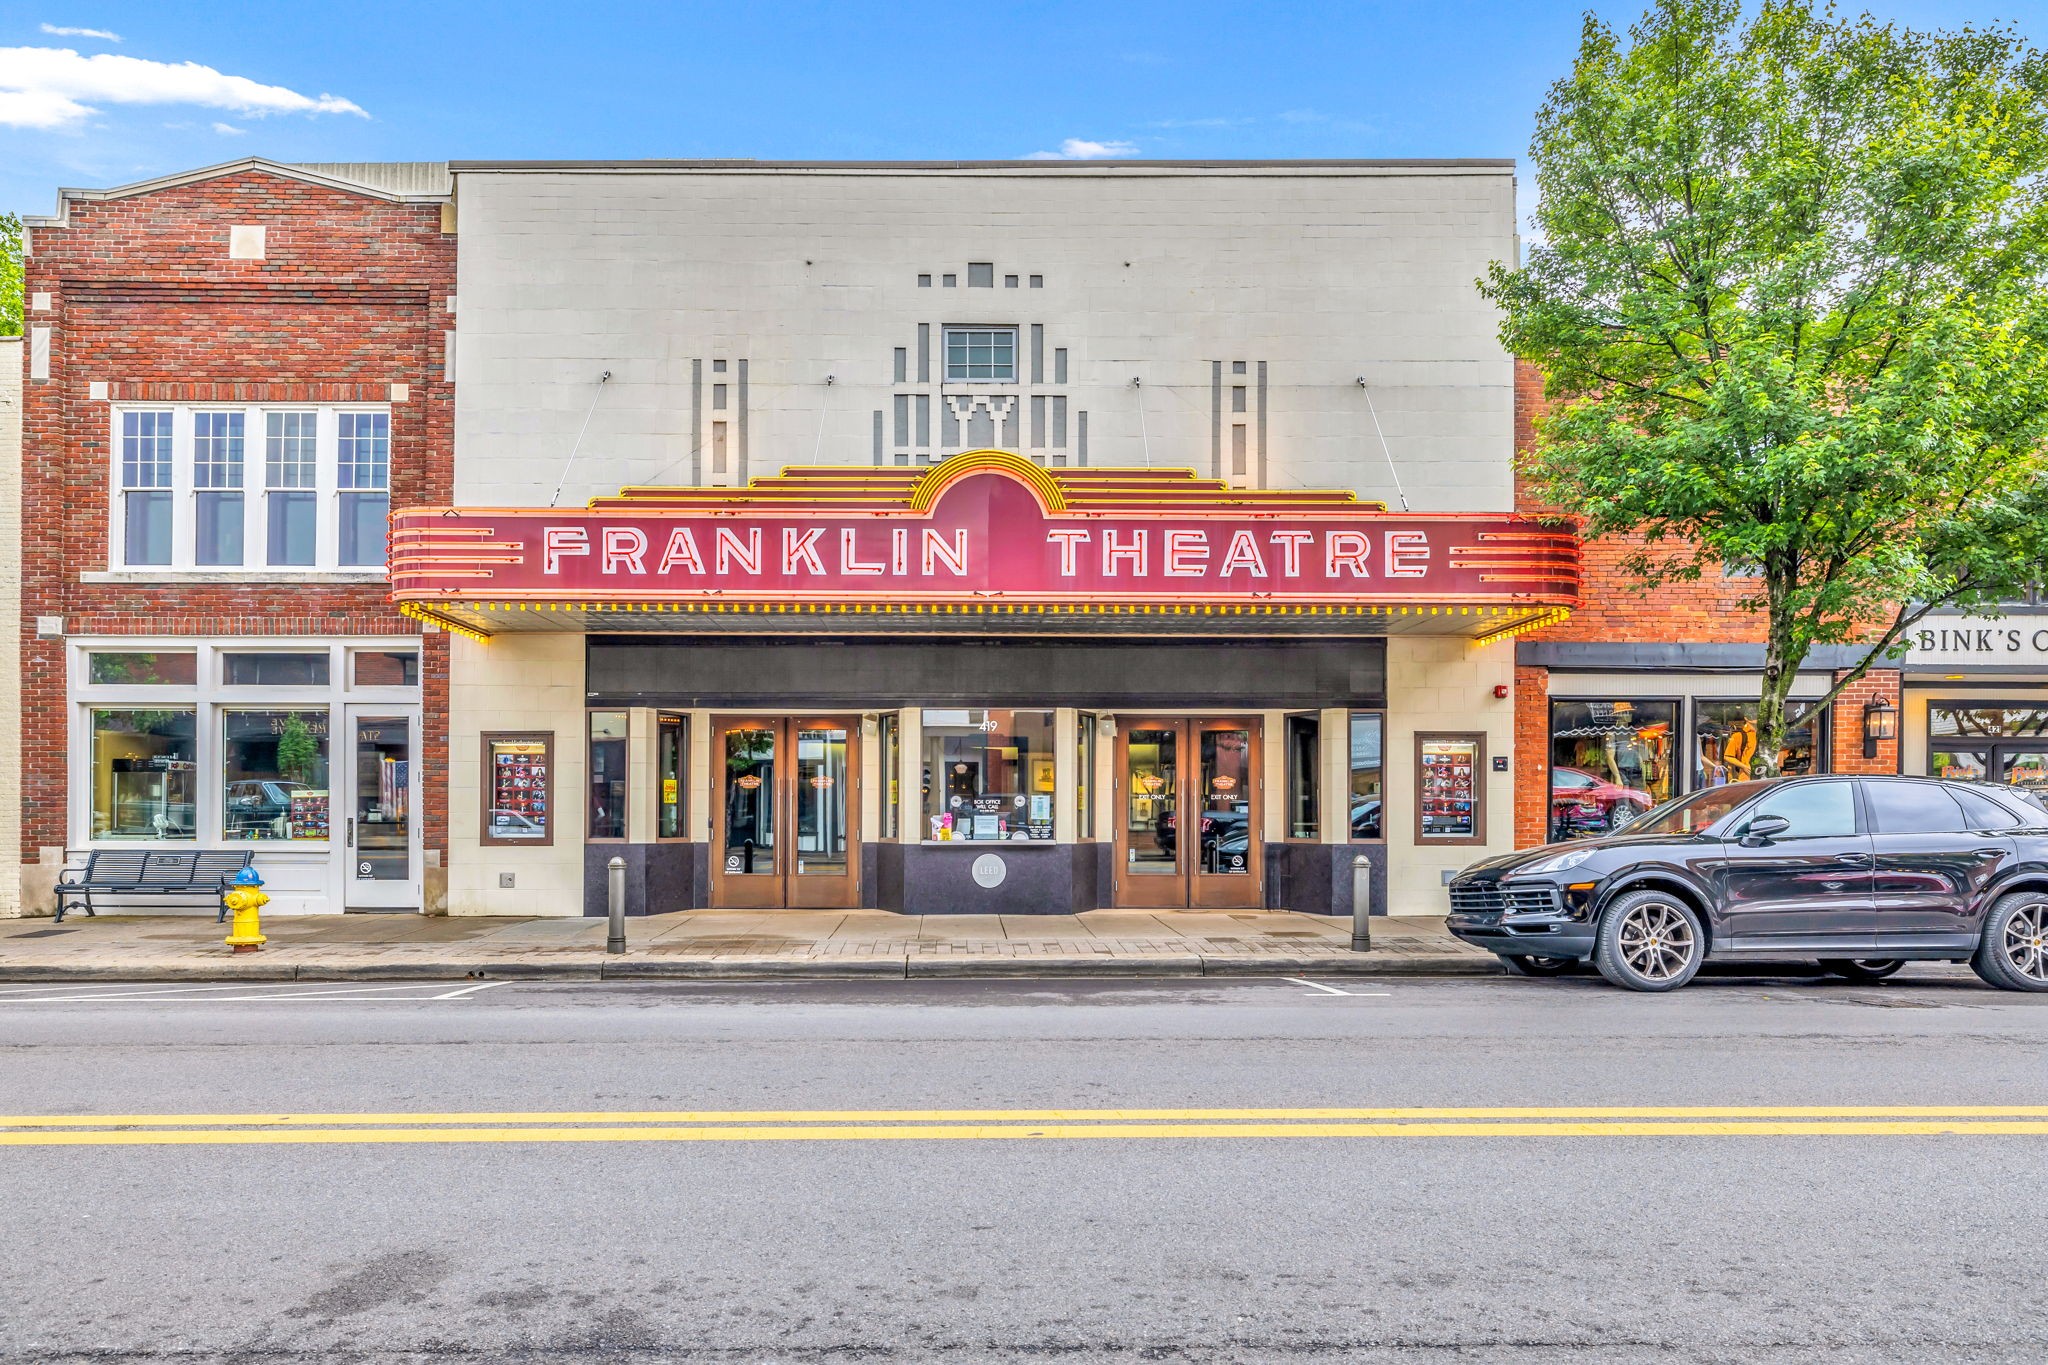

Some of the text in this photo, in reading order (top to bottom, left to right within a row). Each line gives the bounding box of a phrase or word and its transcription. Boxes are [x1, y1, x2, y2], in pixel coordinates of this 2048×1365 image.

[543, 527, 1430, 577] FRANKLIN THEATRE
[1919, 629, 2021, 652] BINK'S
[979, 720, 998, 731] 419
[980, 866, 999, 875] LEED
